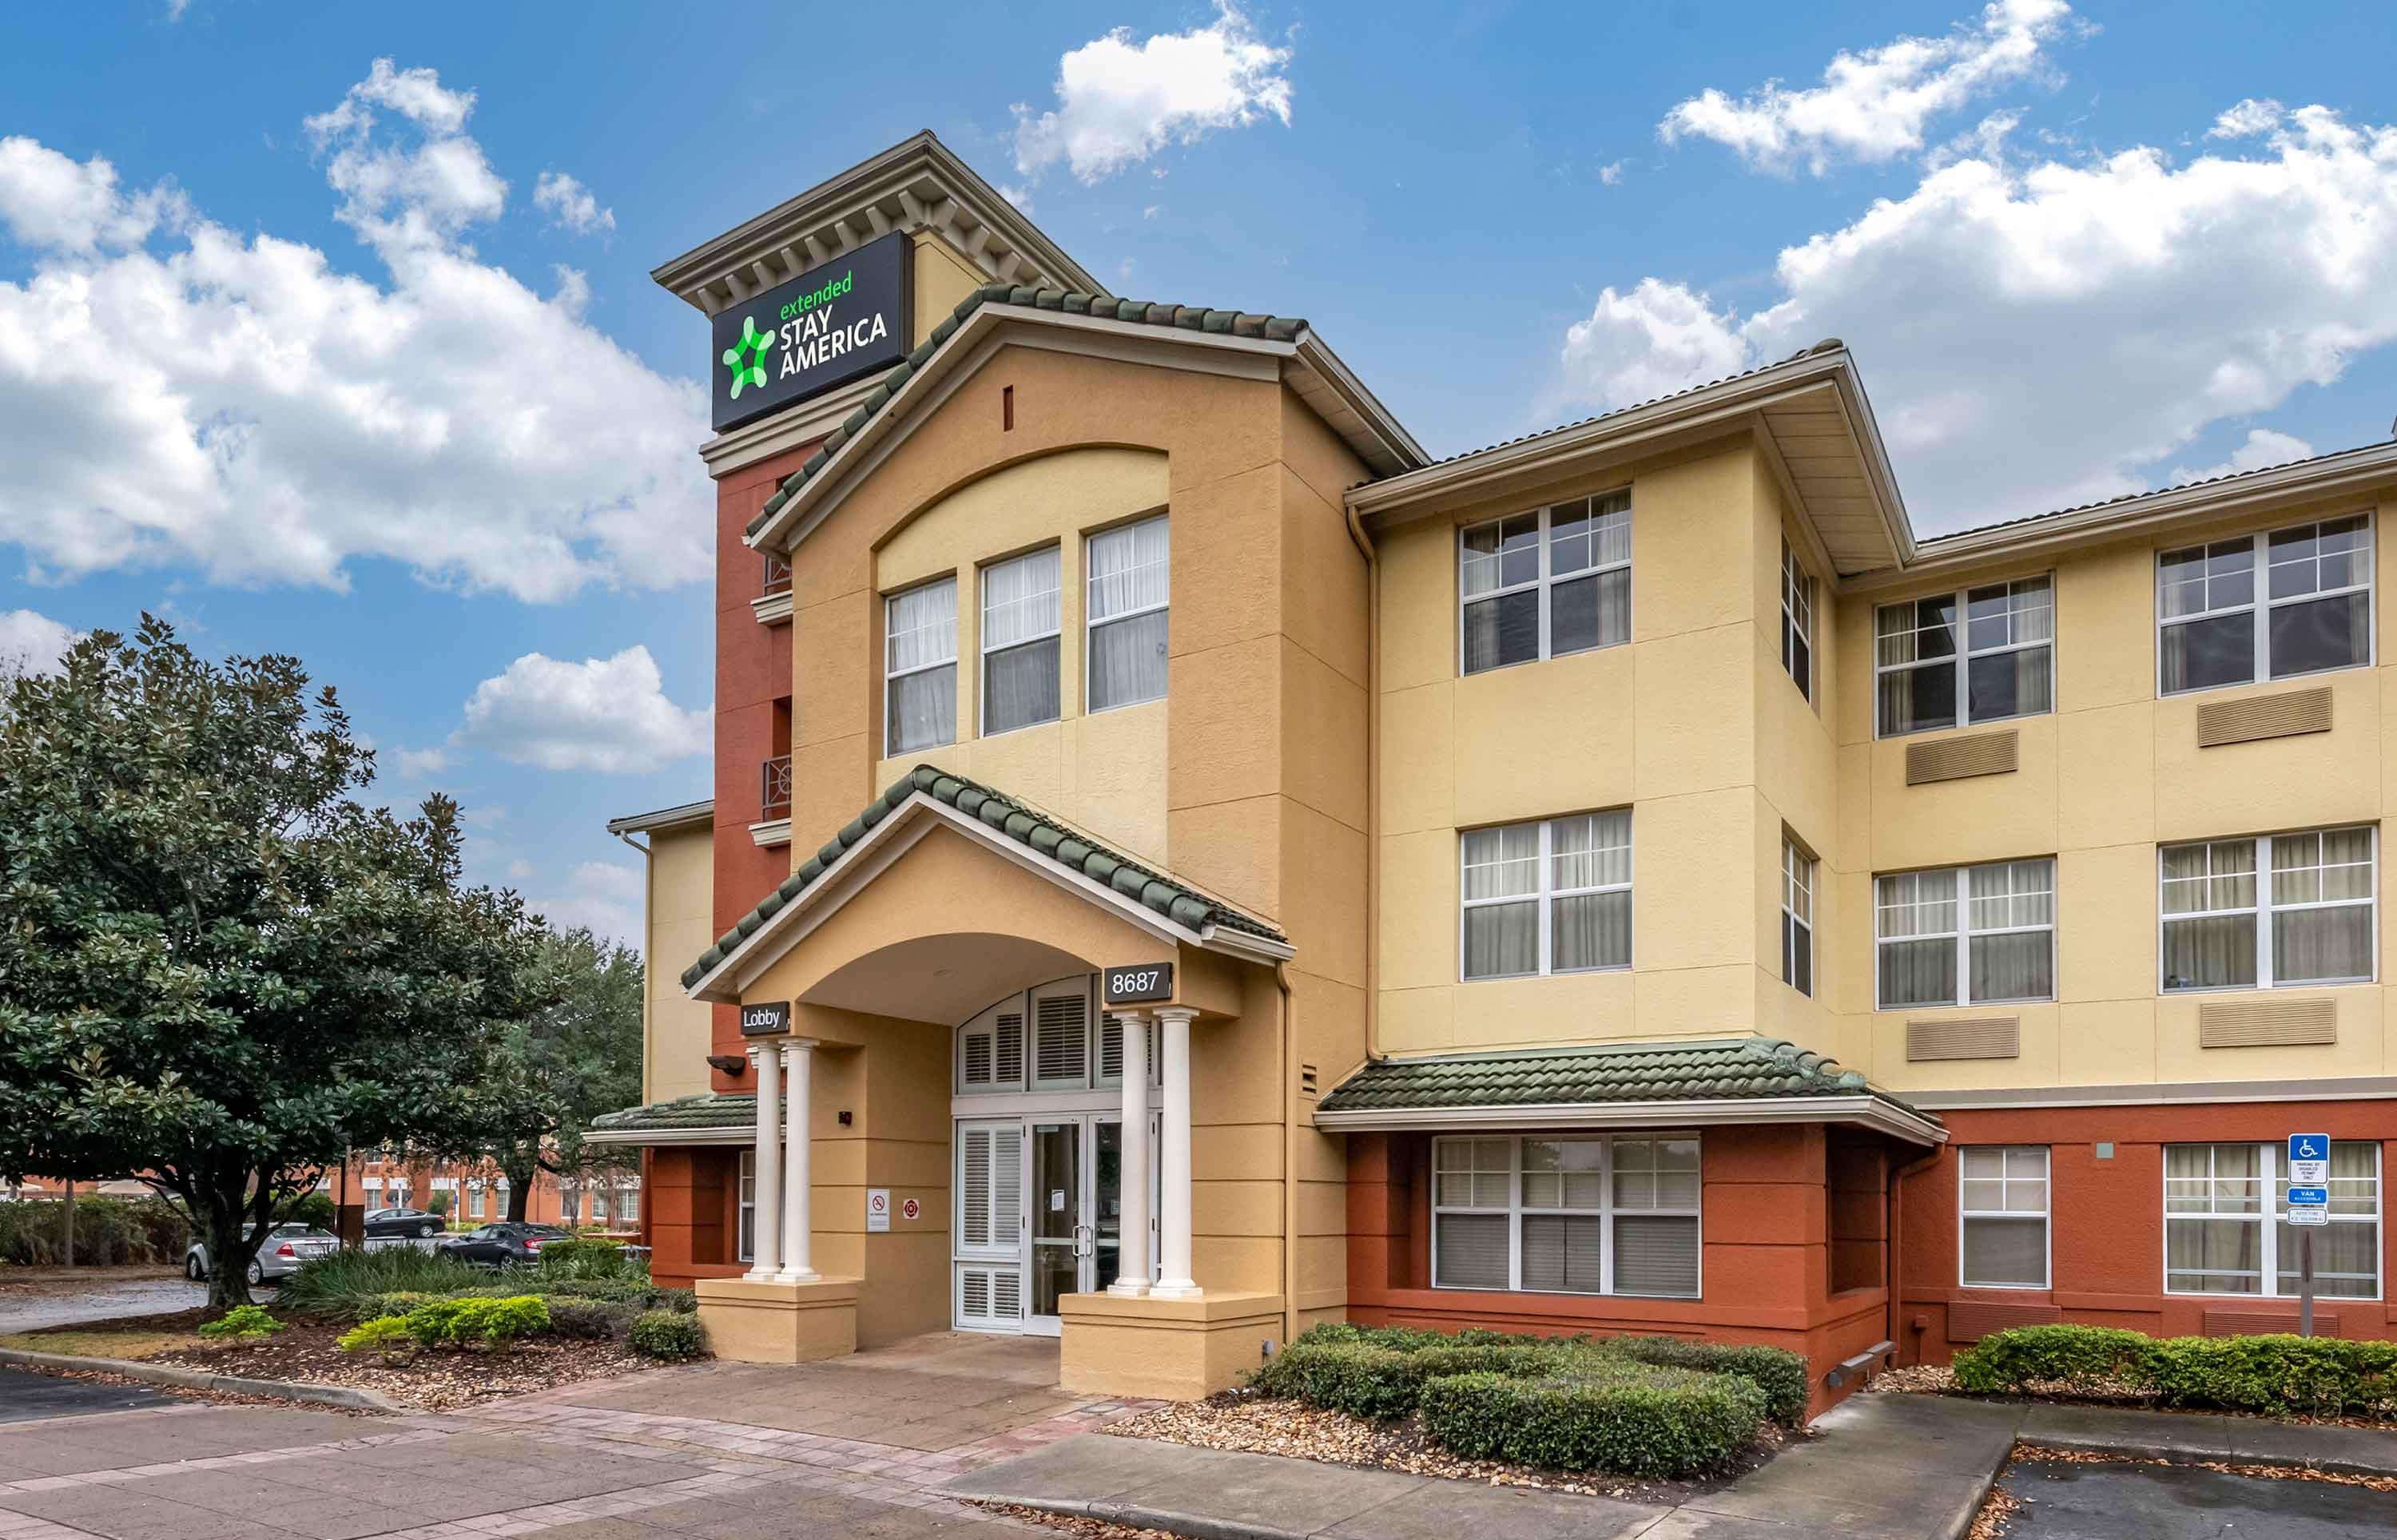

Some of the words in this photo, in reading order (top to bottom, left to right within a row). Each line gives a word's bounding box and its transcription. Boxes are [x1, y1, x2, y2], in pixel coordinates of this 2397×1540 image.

[781, 269, 852, 320] extended
[780, 304, 833, 351] STAY
[780, 312, 888, 380] AMERICA
[1112, 970, 1159, 994] 8687
[744, 1009, 780, 1028] Lobby
